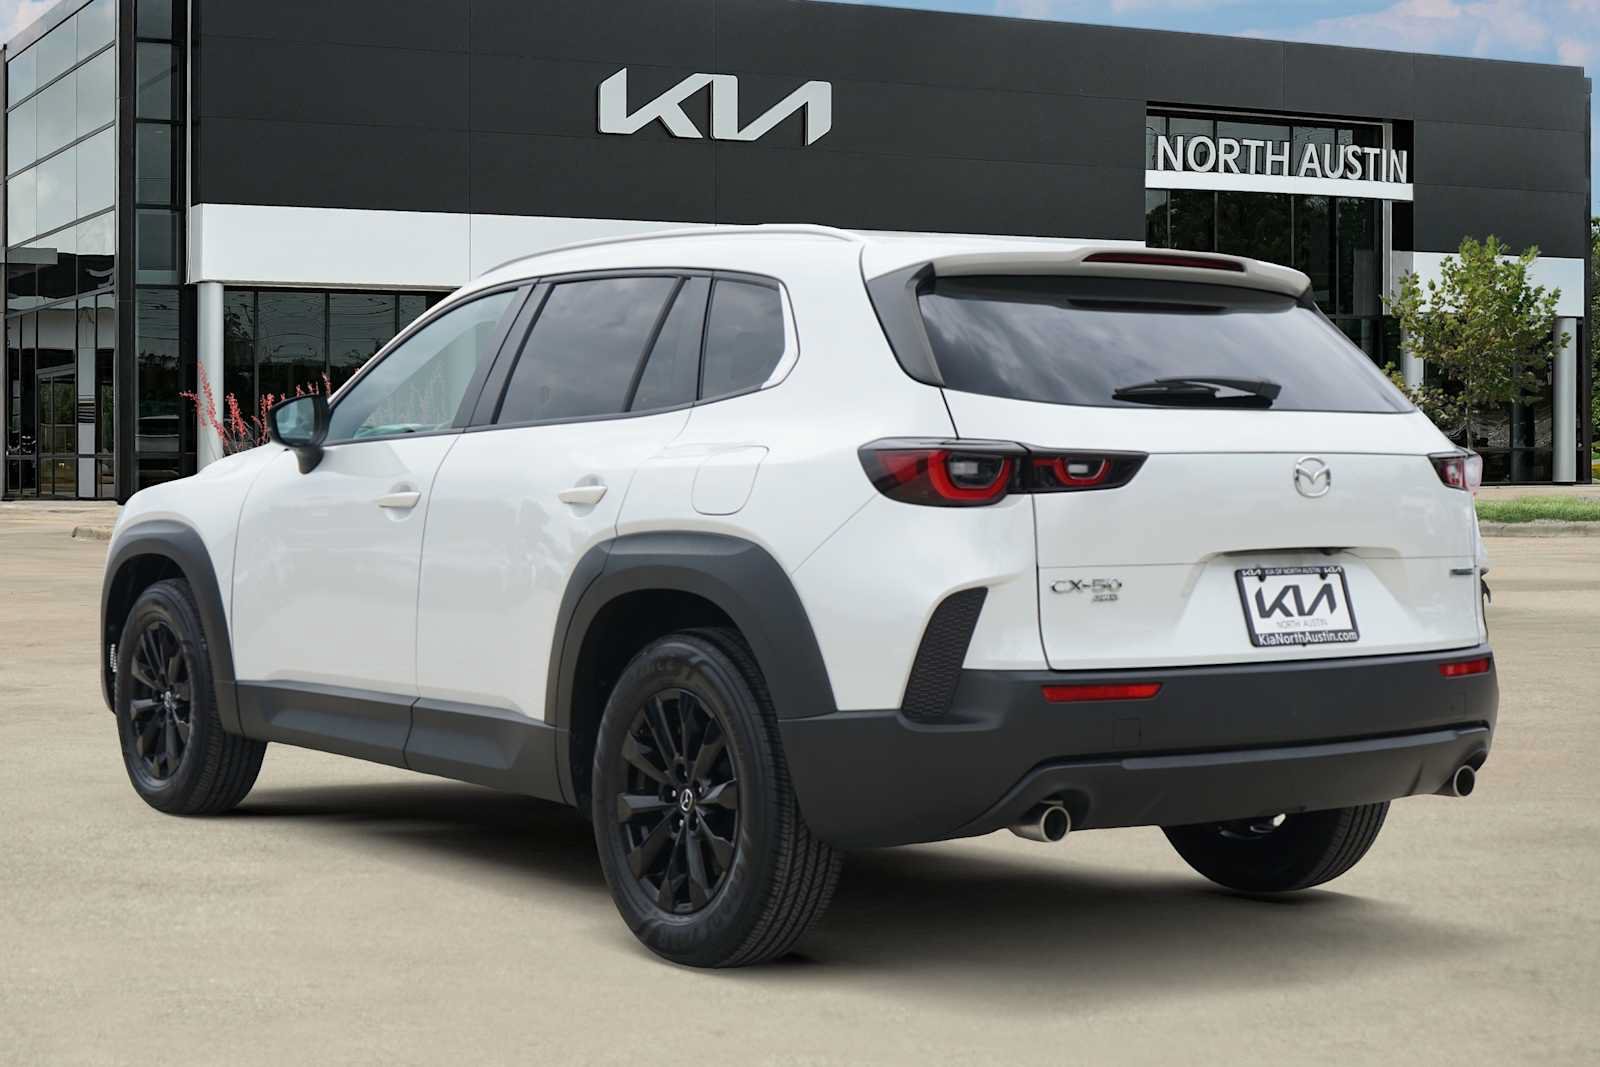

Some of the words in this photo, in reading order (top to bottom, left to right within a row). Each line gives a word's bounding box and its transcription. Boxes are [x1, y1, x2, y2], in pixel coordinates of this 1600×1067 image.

[599, 67, 832, 146] KIA
[1157, 135, 1290, 176] NORTH
[1299, 143, 1408, 184] AUSTIN
[1051, 578, 1122, 593] CX-50
[1255, 584, 1337, 618] KIA
[1276, 620, 1300, 629] NORTH
[1302, 618, 1328, 627] AUSTIN
[1258, 630, 1358, 646] KiaNorthAustin.com
